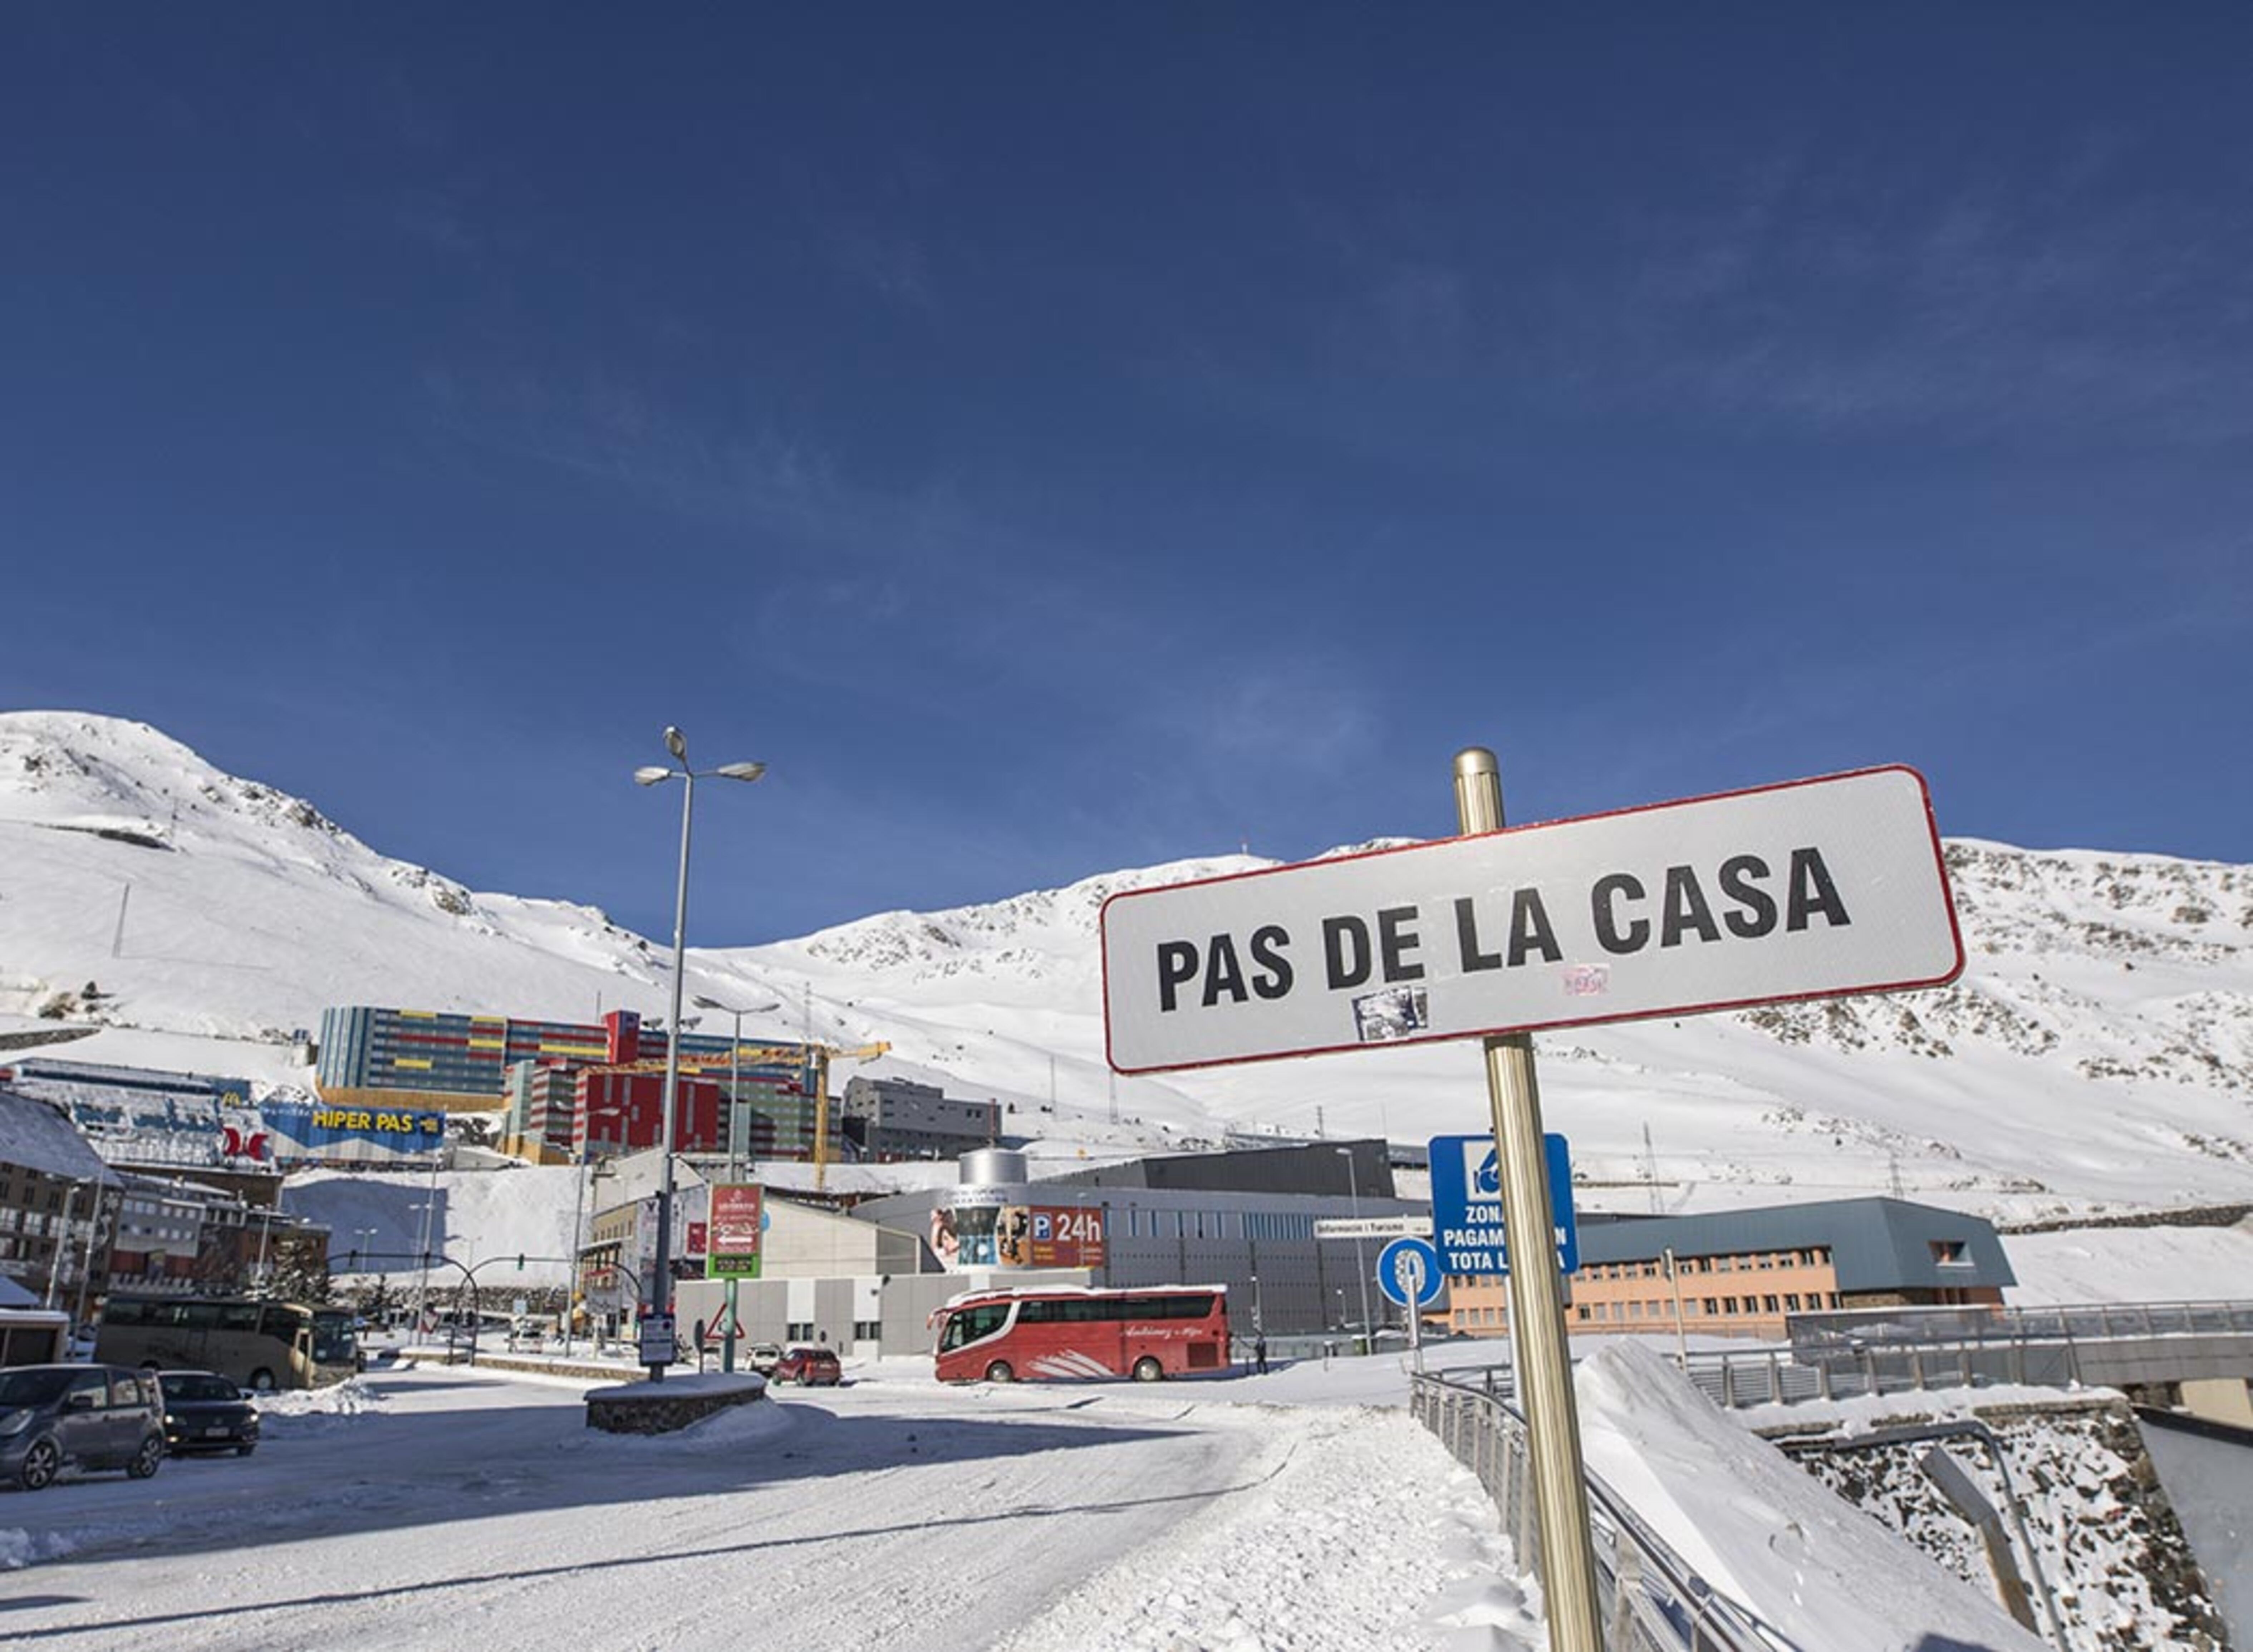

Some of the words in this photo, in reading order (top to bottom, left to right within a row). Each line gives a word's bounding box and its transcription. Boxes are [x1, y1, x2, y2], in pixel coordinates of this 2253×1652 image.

[1157, 925, 1294, 1013] PAS
[1322, 905, 1425, 990] DE
[1454, 888, 1563, 973] LA
[1591, 847, 1852, 955] CASA
[312, 1110, 370, 1129] HIPER
[376, 1114, 412, 1132] PAS
[1466, 1205, 1505, 1223] ZON
[1057, 1213, 1101, 1242] 24h
[1443, 1228, 1505, 1247] PAGAM
[1448, 1252, 1493, 1270] TOTA
